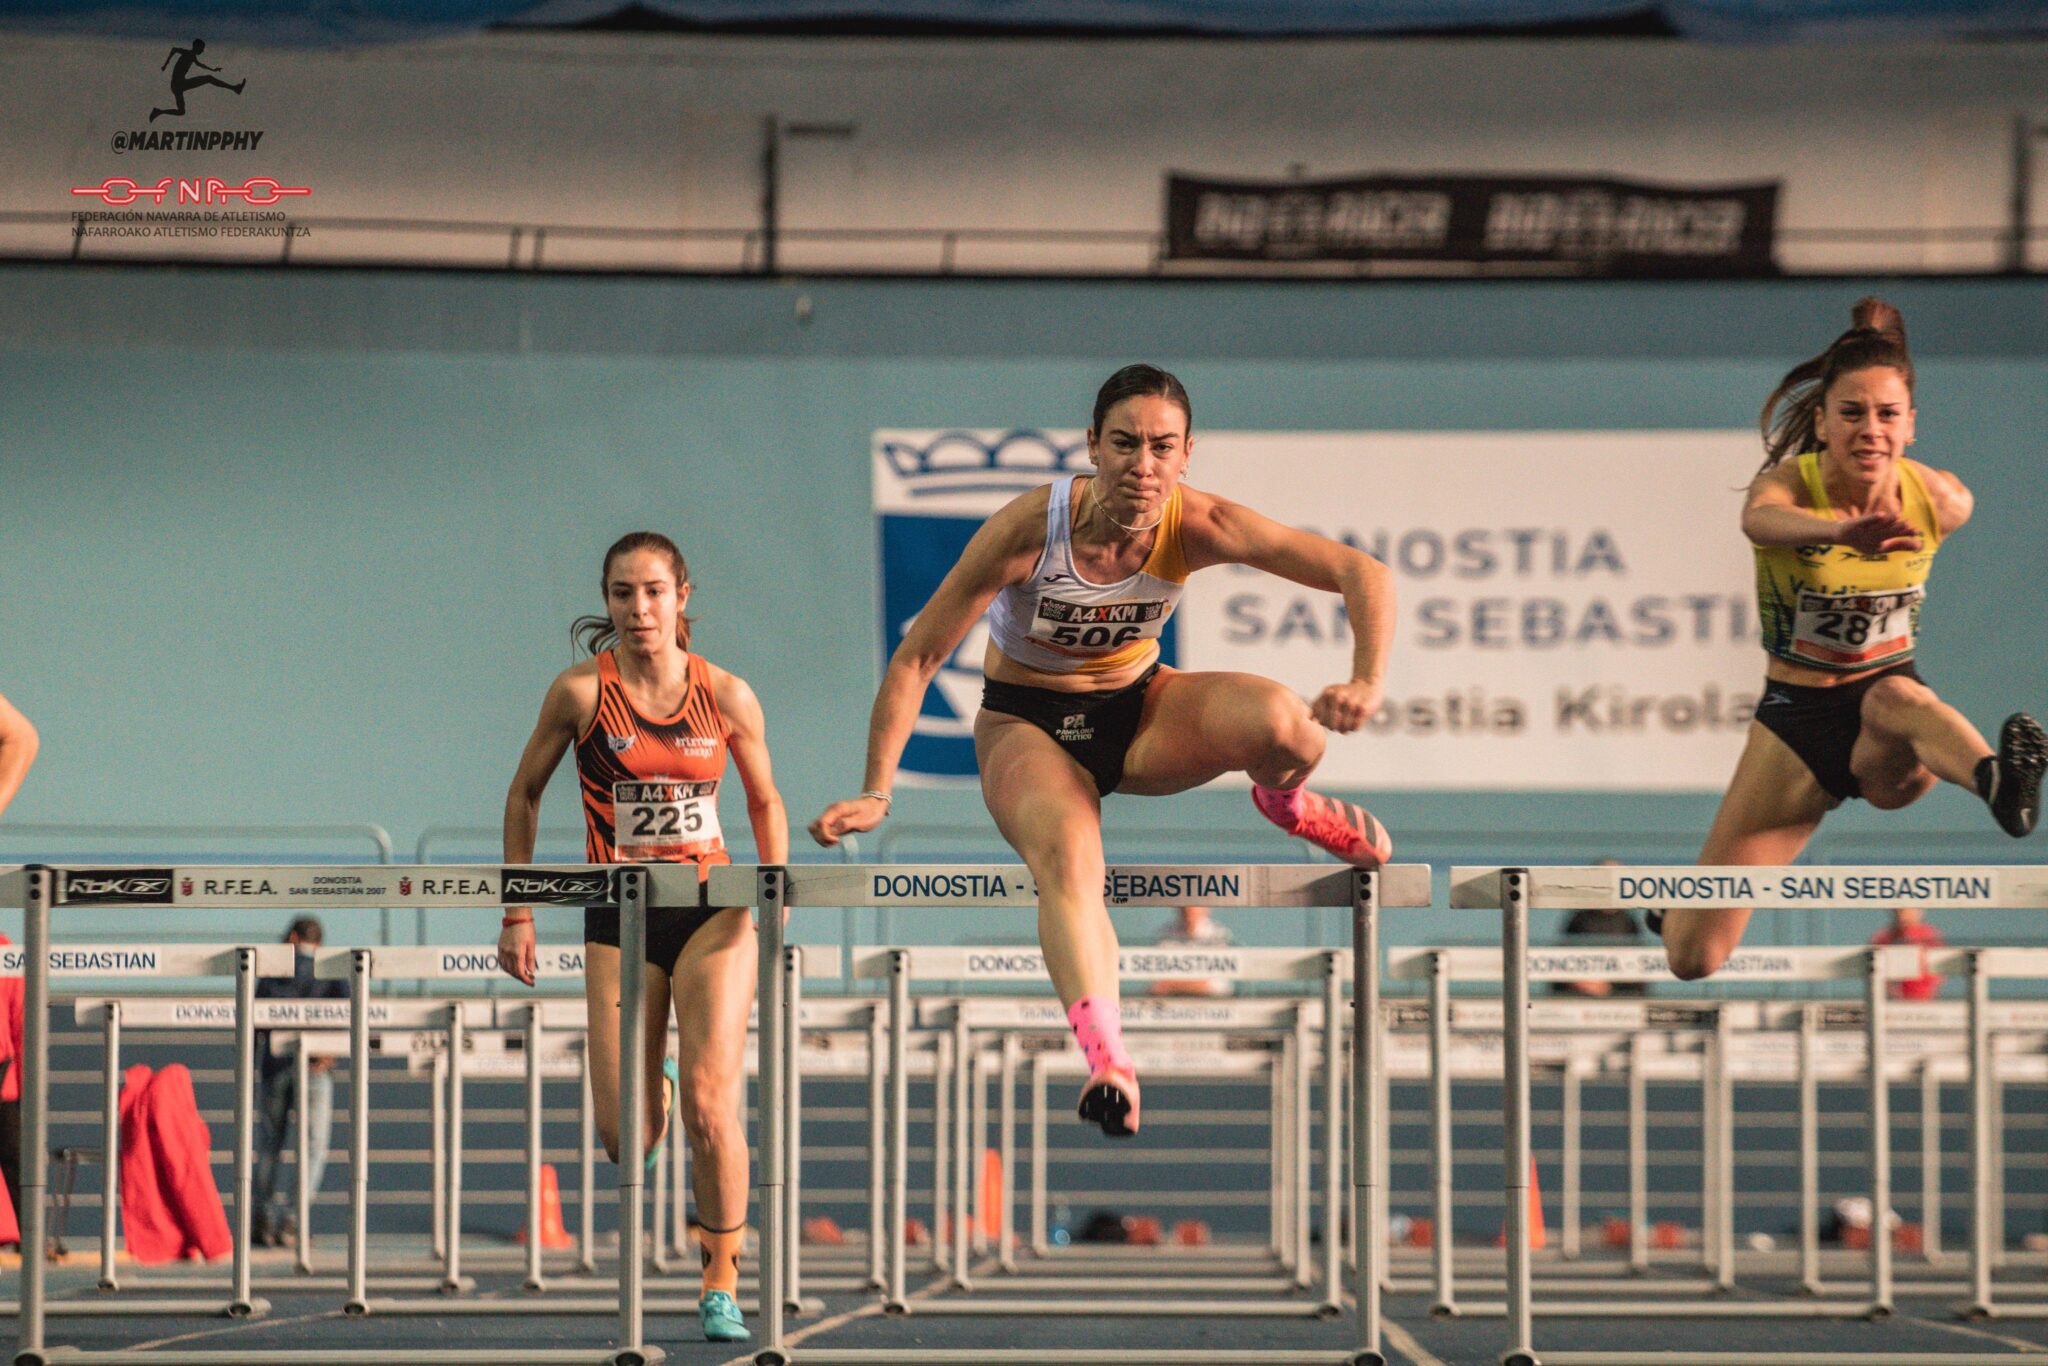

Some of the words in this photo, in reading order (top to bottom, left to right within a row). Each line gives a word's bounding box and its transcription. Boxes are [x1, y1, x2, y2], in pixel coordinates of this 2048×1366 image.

[1228, 528, 1624, 577] NOSTIA
[1069, 607, 1137, 622] A4XKM
[1415, 594, 1764, 649] SEBASTI
[1050, 626, 1142, 647] 506
[641, 785, 694, 801] A4XKM
[631, 802, 703, 836] 225
[204, 880, 278, 895] R.F.E.A.
[313, 876, 362, 884] DONOSTIA
[422, 879, 496, 895] R.F.E.A.
[874, 876, 1007, 897] DONOSTIA
[1619, 877, 1753, 898] DONOSTIA
[1781, 877, 1834, 898] SAN
[1844, 877, 1990, 899] SEBASTIAN
[288, 887, 309, 895] SAN
[49, 952, 155, 969] SEBASTIAN
[559, 954, 584, 970] SA
[969, 955, 1045, 972] DONOST
[1131, 956, 1238, 972] SEBASTIAN
[176, 1004, 236, 1020] DONOS
[304, 1006, 388, 1020] SEBASAN
